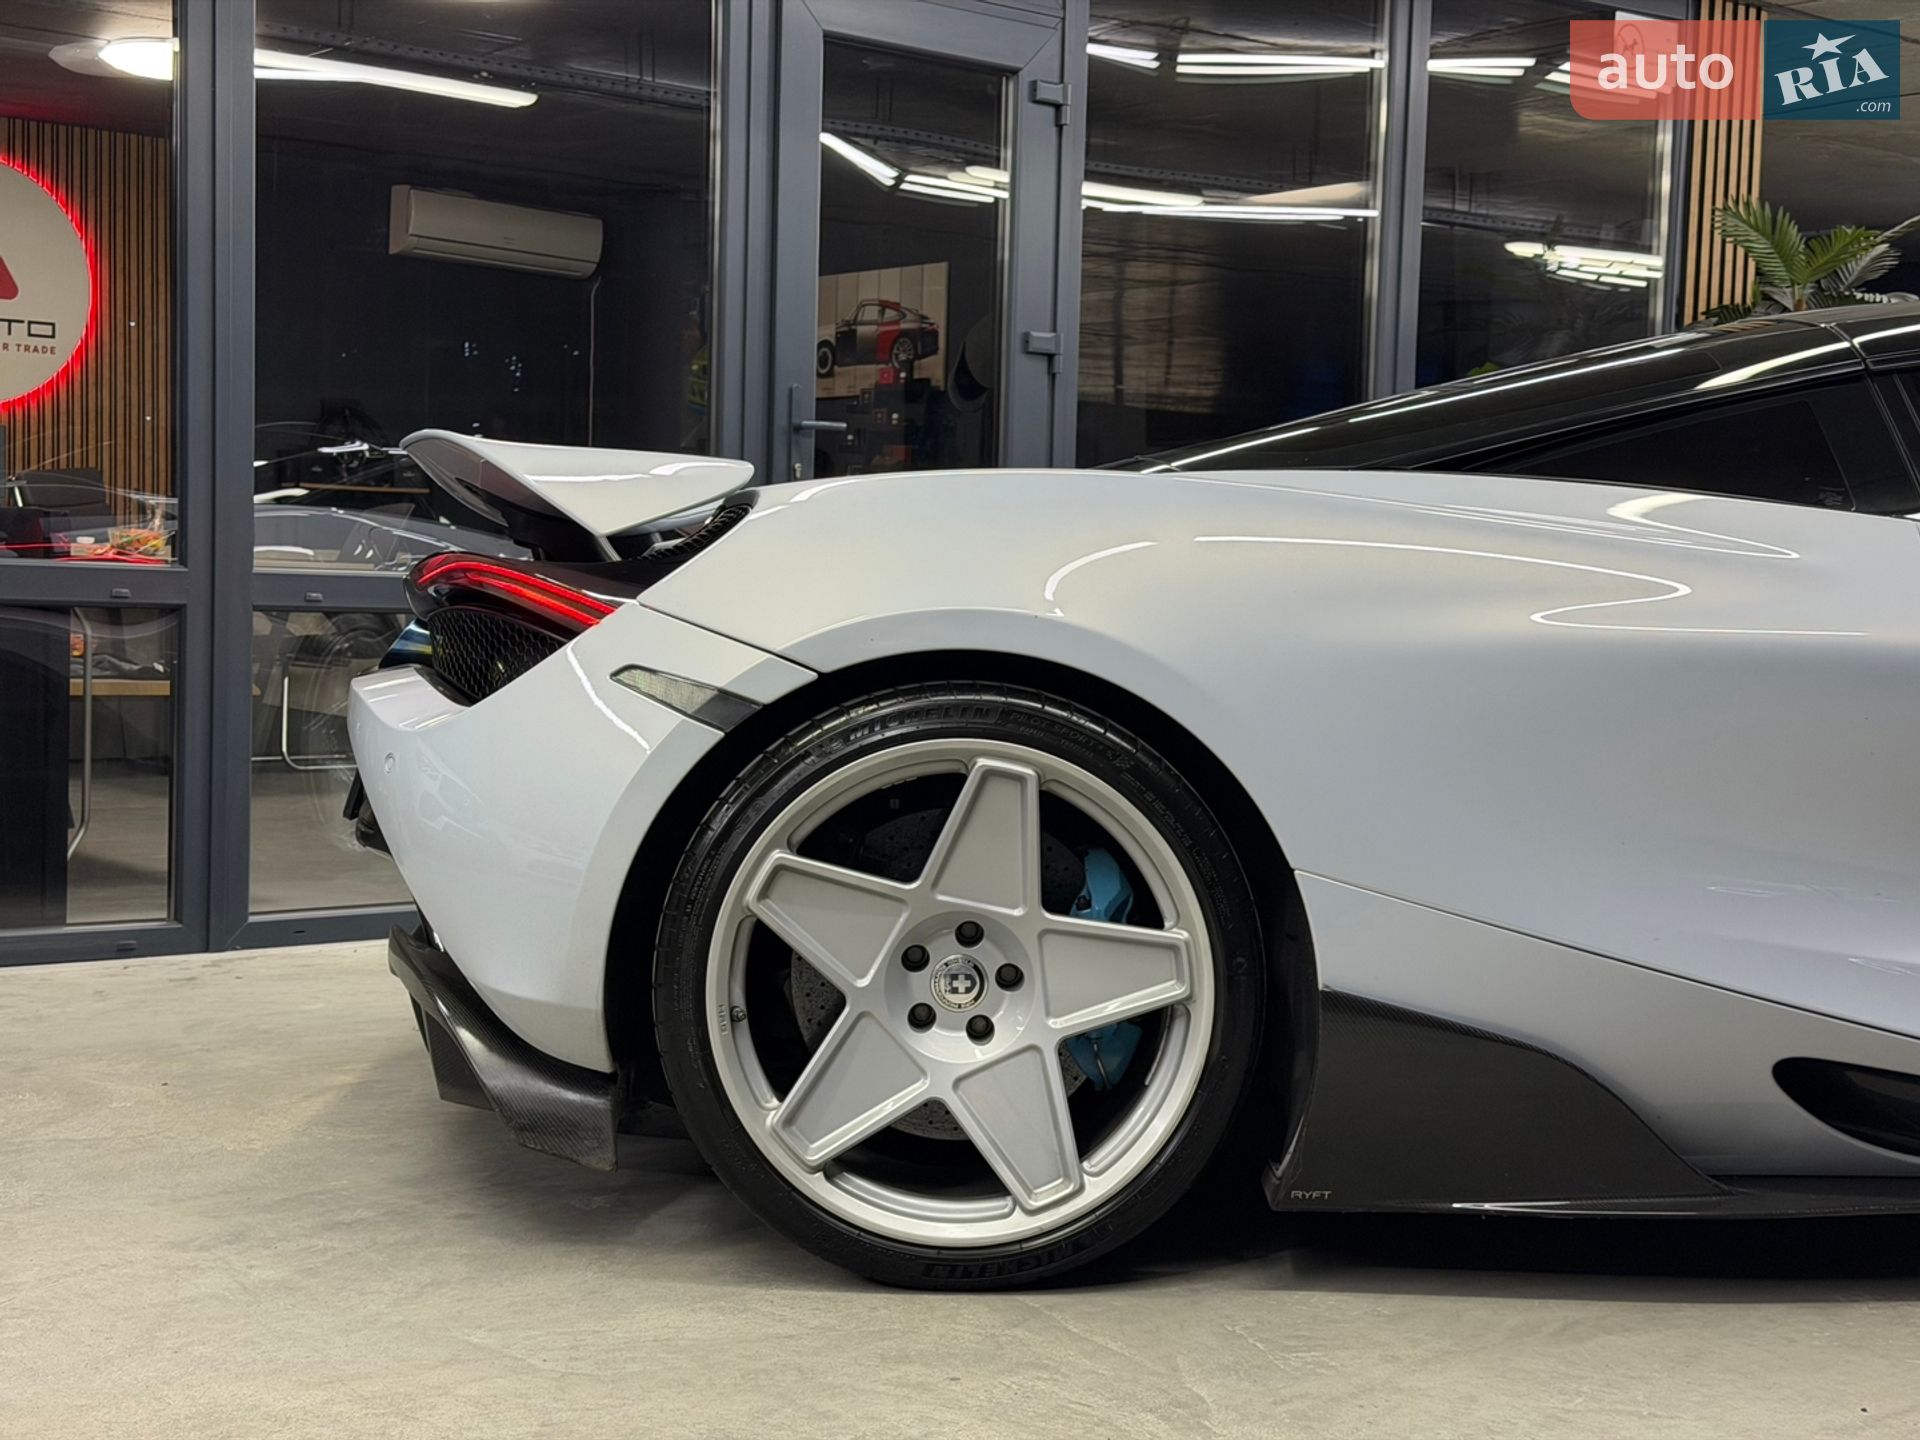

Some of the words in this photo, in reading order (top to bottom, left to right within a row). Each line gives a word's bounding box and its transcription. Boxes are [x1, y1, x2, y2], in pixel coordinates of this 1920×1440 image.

[15, 343, 56, 355] TRADE
[850, 707, 991, 740] MICHELIN
[1291, 1190, 1332, 1200] RYFT
